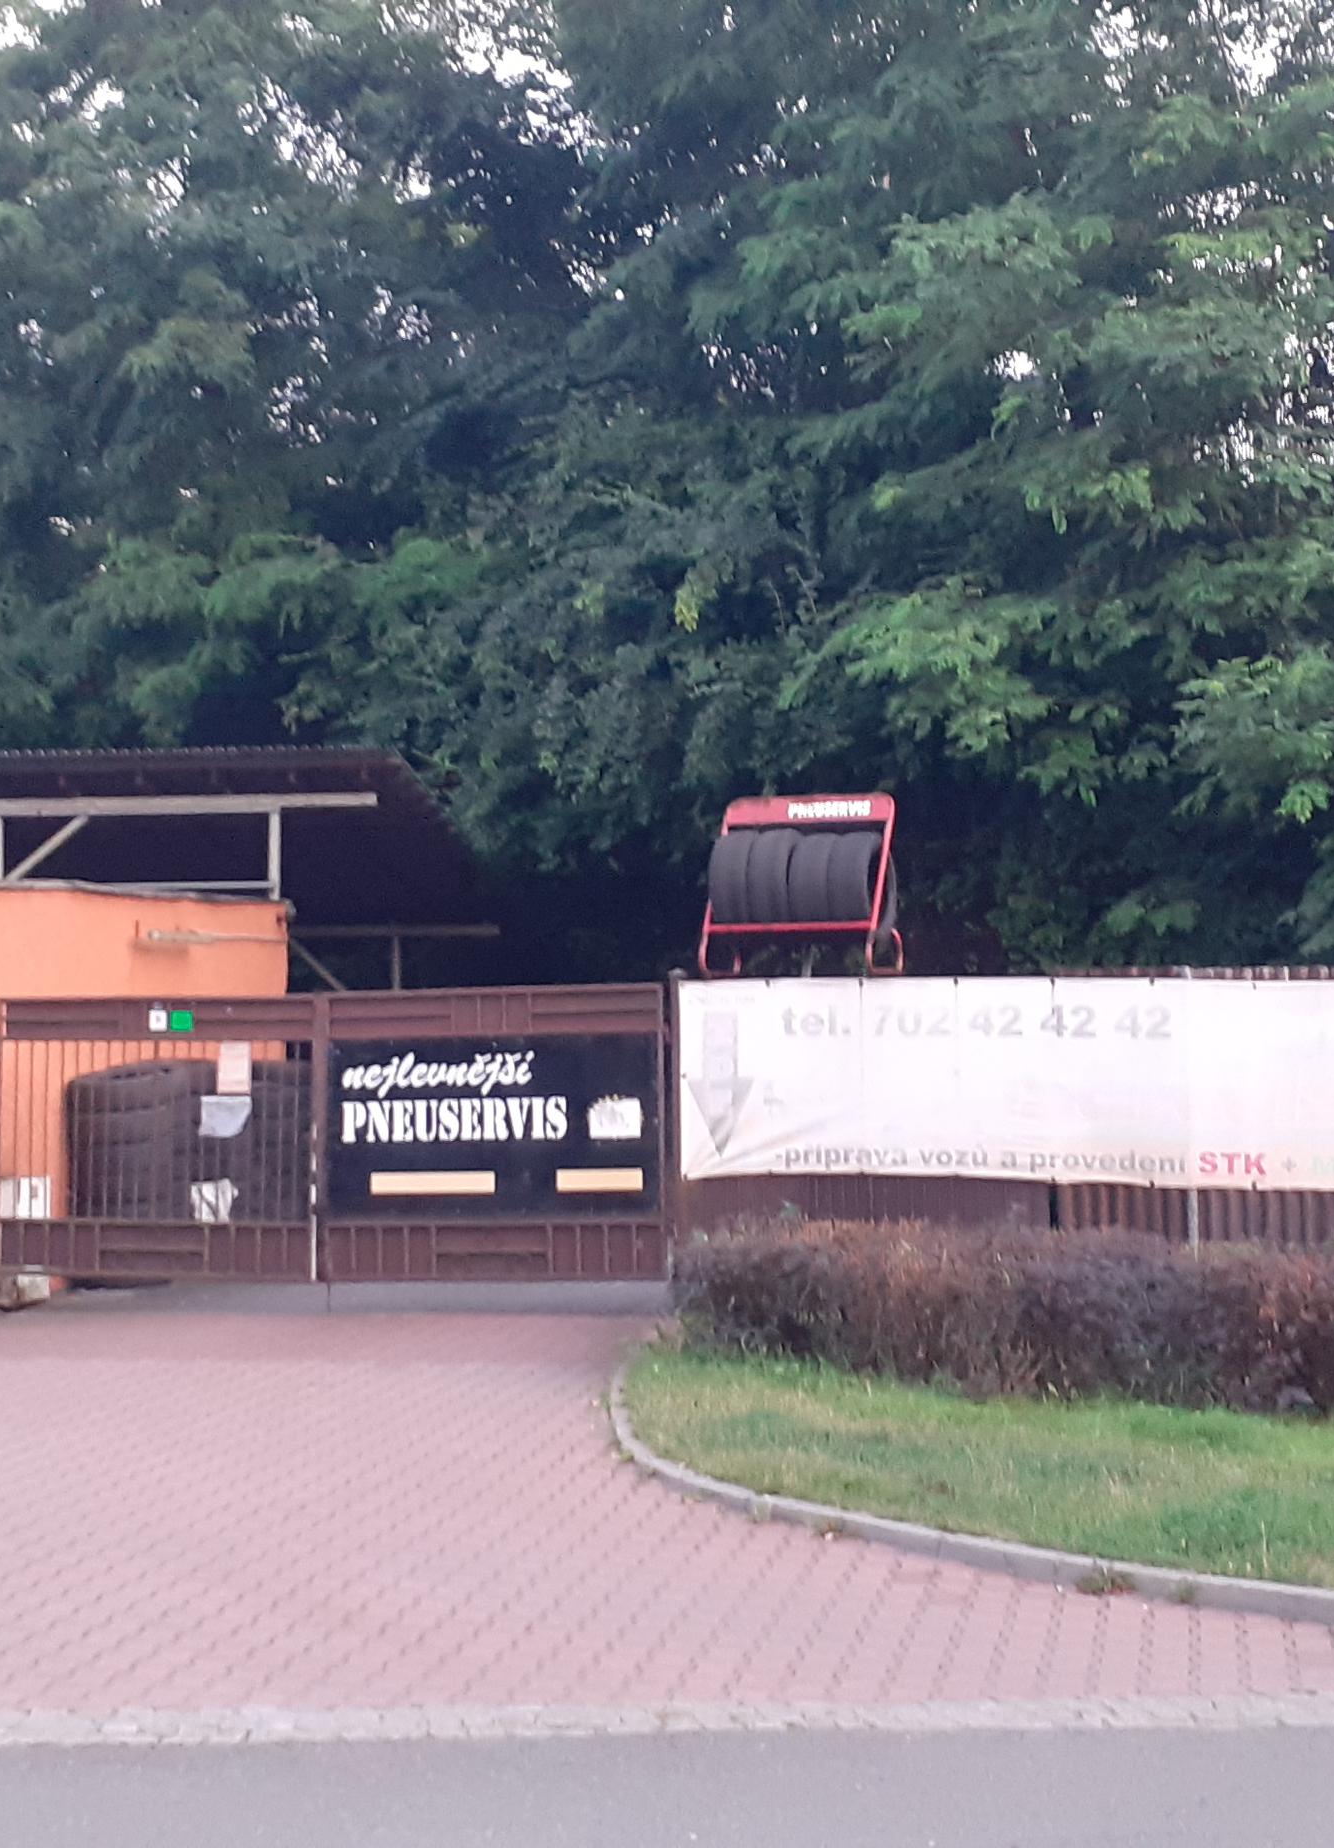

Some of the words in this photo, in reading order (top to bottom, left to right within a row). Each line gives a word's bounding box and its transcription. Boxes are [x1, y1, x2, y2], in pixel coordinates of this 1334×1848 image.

[787, 799, 872, 819] PNEUSERVIS
[781, 1004, 852, 1037] tel.
[874, 1005, 953, 1038] 702
[969, 1004, 1024, 1038] 42
[1039, 1003, 1097, 1038] 42
[1113, 1004, 1173, 1039] 42
[341, 1050, 535, 1098] nejlevnější
[341, 1096, 568, 1143] PNEUSERVIS
[1001, 1151, 1017, 1169] a
[1199, 1151, 1267, 1176] STK
